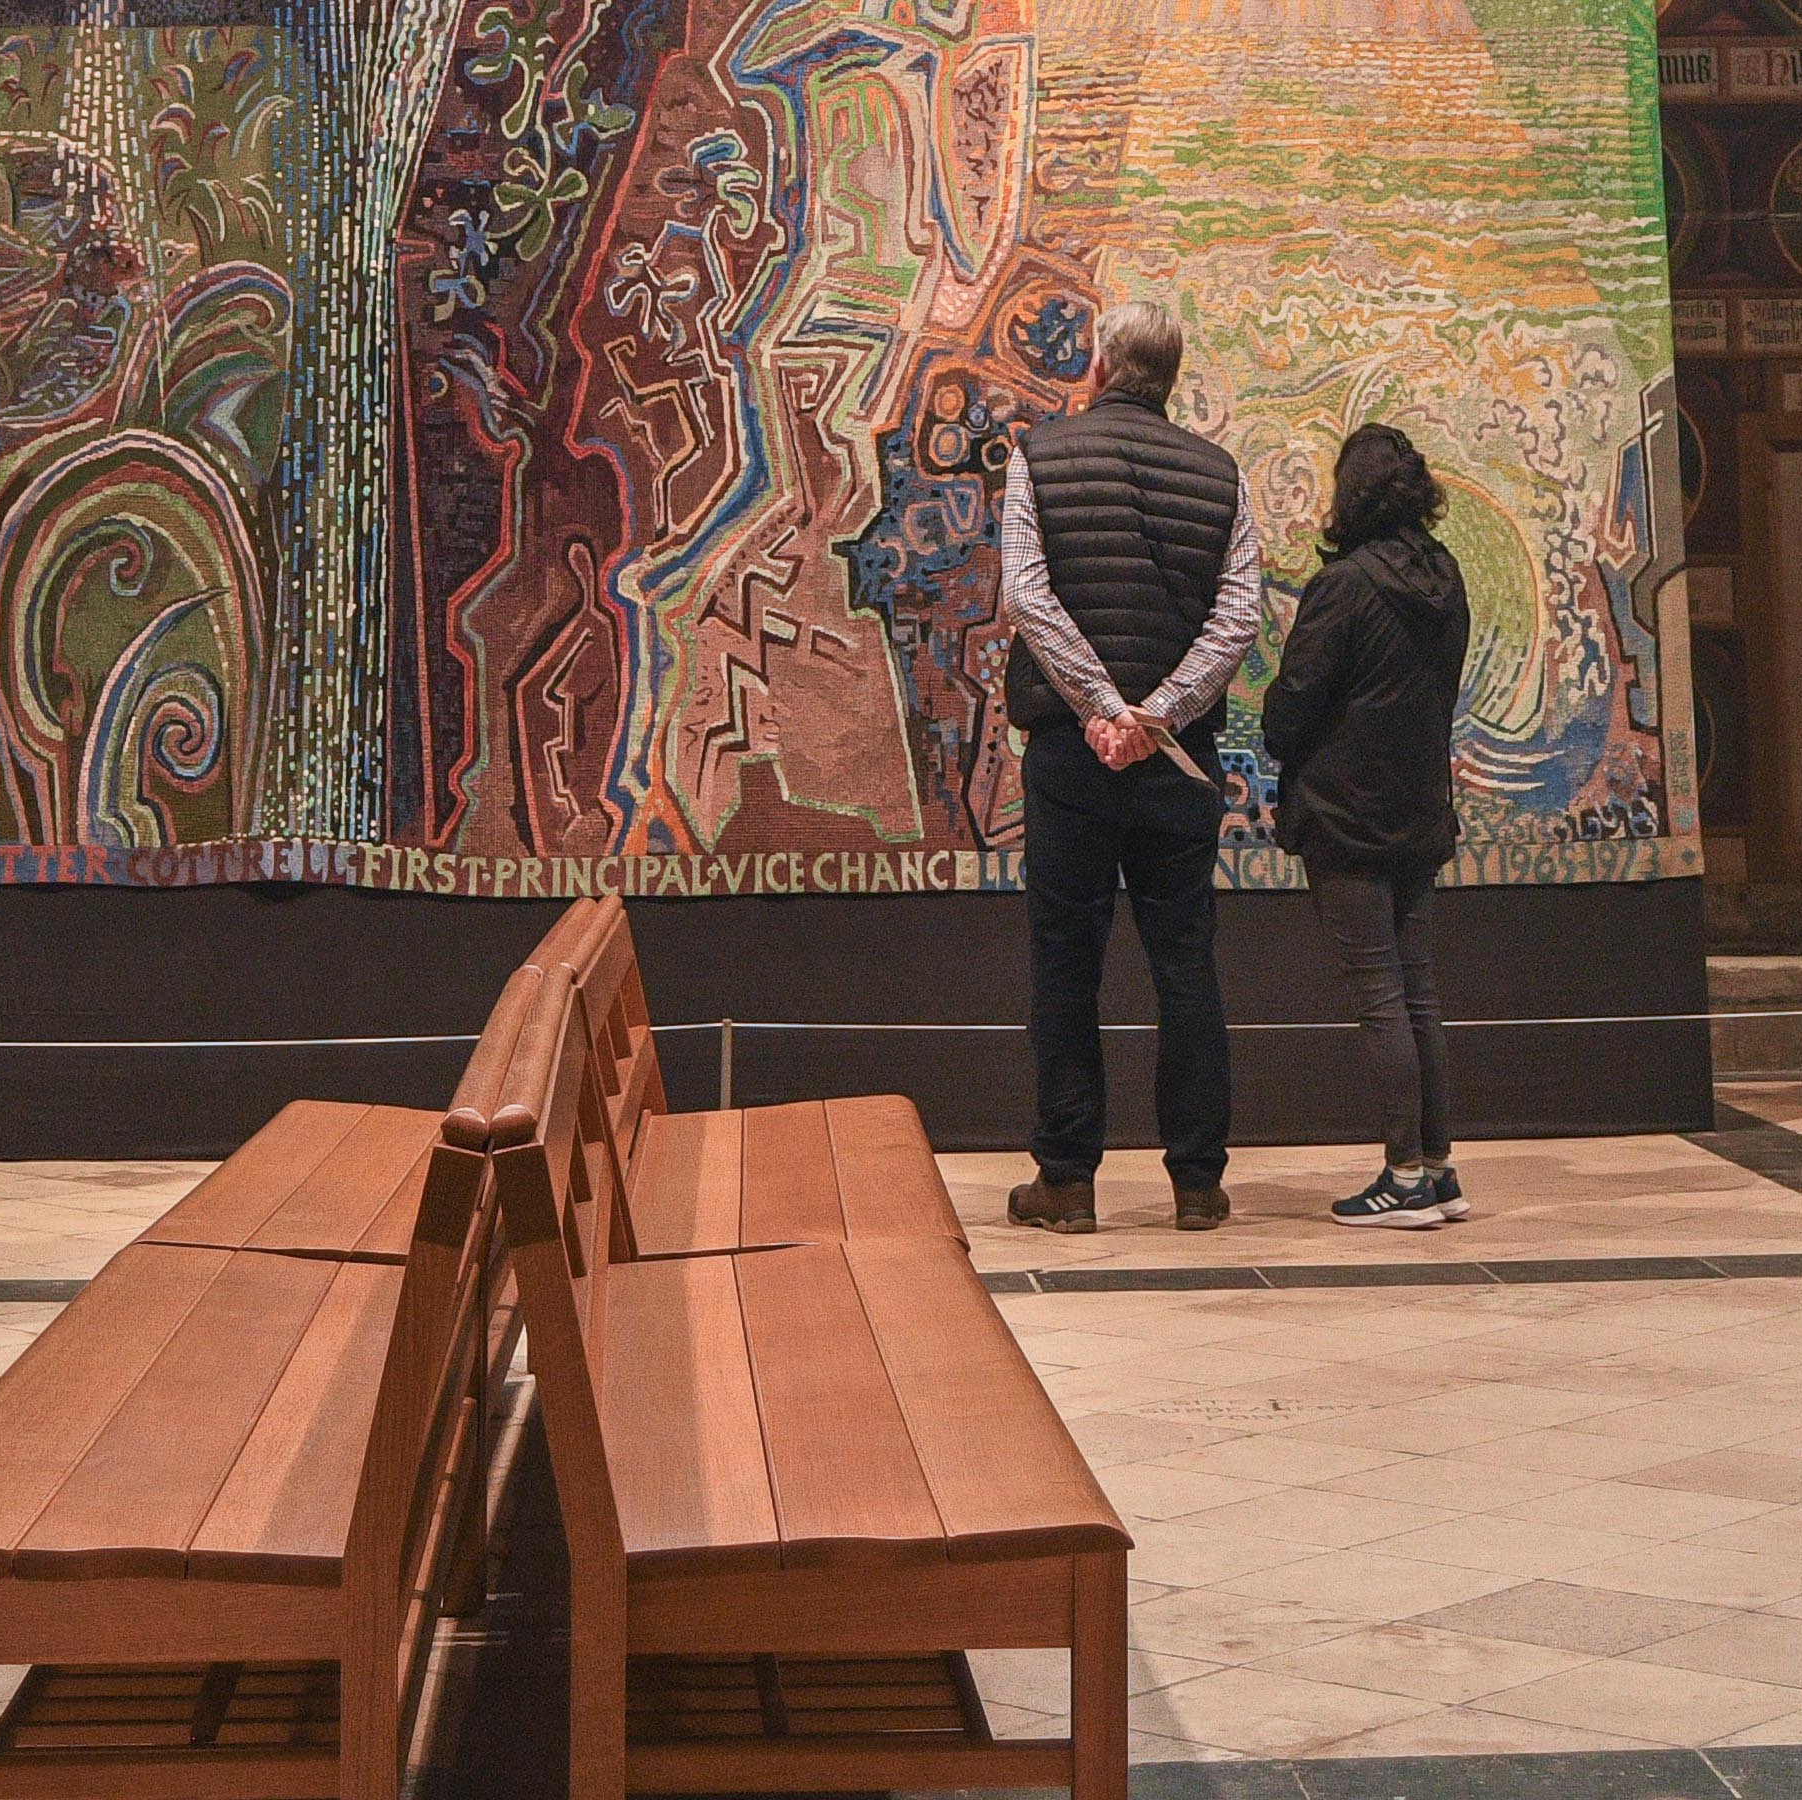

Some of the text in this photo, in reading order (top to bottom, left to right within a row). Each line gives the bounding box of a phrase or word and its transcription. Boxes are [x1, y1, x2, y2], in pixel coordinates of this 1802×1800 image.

[361, 847, 481, 895] FIRST
[496, 854, 712, 898] PRINCIPAL
[715, 852, 805, 894] VICE
